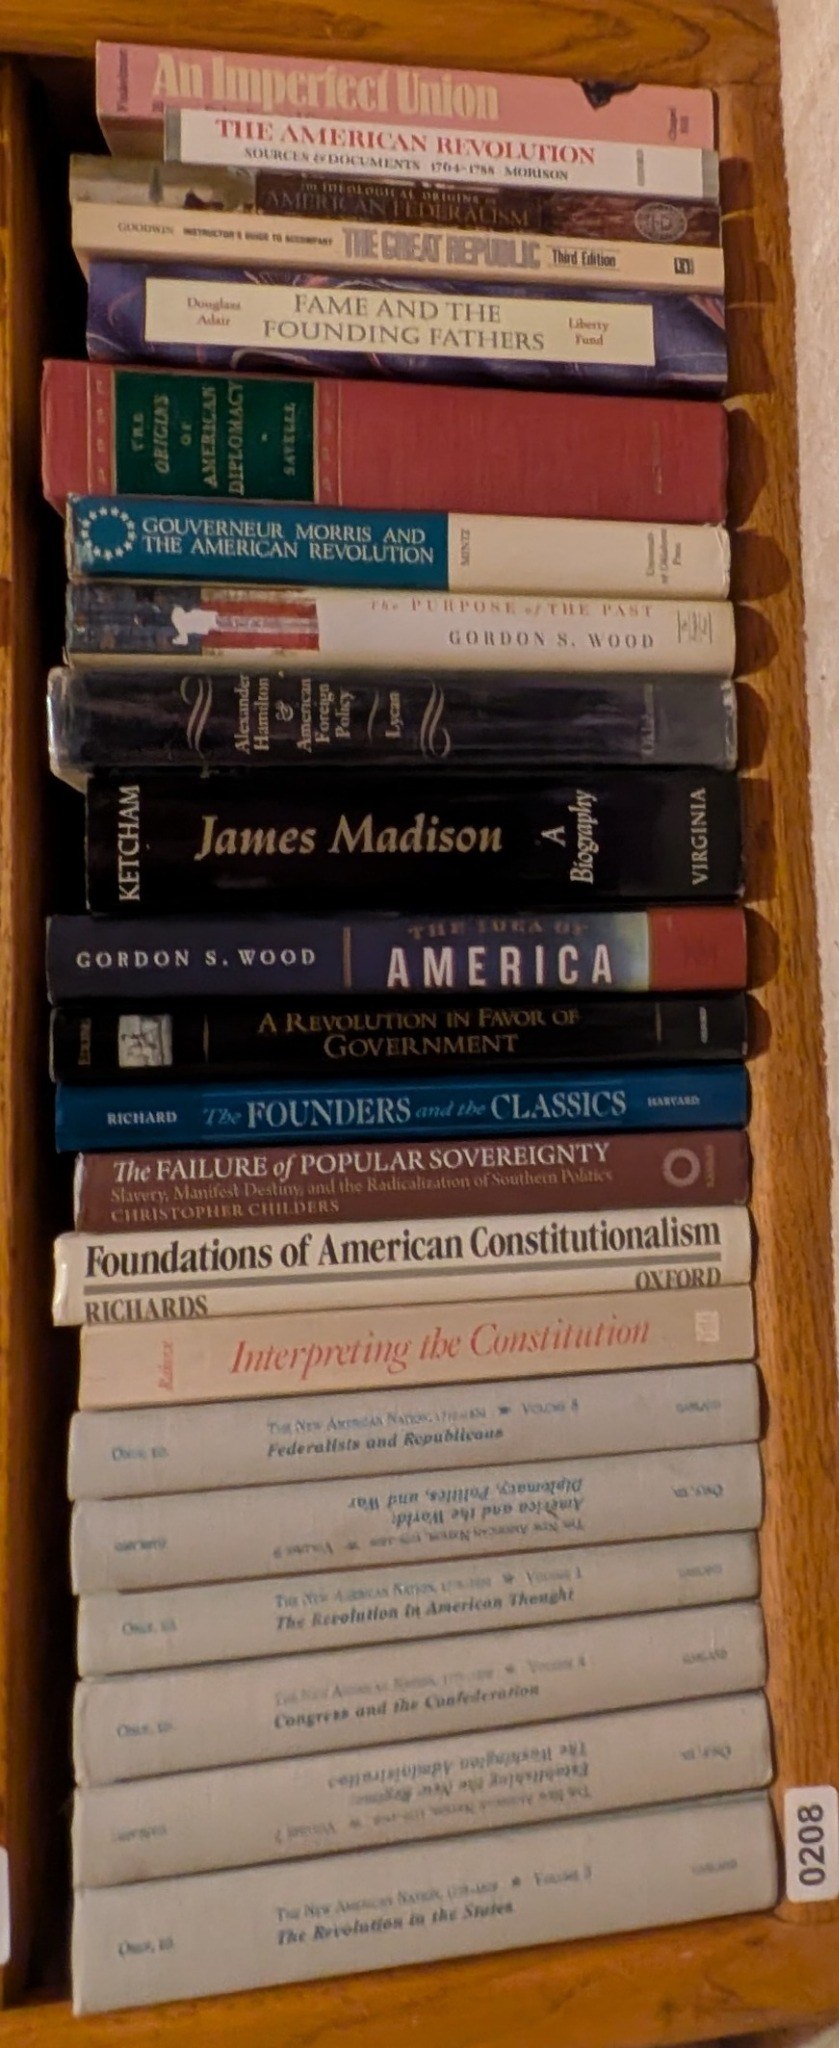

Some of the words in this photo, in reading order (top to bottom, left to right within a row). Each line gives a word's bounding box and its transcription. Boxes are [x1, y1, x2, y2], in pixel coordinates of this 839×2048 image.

[153, 52, 204, 98] An
[212, 55, 389, 112] Imperfect
[397, 69, 499, 121] Union
[215, 118, 273, 141] THE
[280, 123, 428, 152] AMERICAN
[437, 136, 596, 164] REVOLUTION
[245, 147, 309, 162] SOURCES
[328, 153, 420, 171] DOCUMENTS
[504, 166, 569, 181] MORISON
[266, 190, 386, 217] AMERICAN
[392, 200, 529, 227] FEDERALISM
[118, 222, 174, 235] GOODWIN
[342, 227, 377, 258] THE
[381, 229, 443, 264] GREAT
[446, 233, 541, 269] REPUBLIC
[553, 249, 577, 266] Third
[582, 251, 616, 267] Edition
[187, 297, 241, 311] Douglass
[295, 293, 367, 317] FAME
[377, 298, 438, 320] AND
[445, 302, 501, 323] THE
[196, 314, 231, 326] Adair
[263, 320, 420, 345] FOUNDING
[430, 327, 544, 351] FATHERS
[569, 317, 609, 332] Liberty
[575, 334, 603, 346] Fund
[154, 393, 170, 475] ORIGINS
[180, 421, 192, 446] OF
[201, 385, 218, 489] AMERICAN
[228, 380, 244, 496] DIPLOMACY
[141, 517, 283, 539] GOUVERNEUR
[295, 522, 372, 543] MORRIS
[384, 526, 426, 545] AND
[142, 536, 182, 554] THE
[191, 540, 298, 559] AMERICAN
[310, 543, 434, 565] REVOLUTION
[412, 599, 517, 616] PURPOSE
[550, 602, 585, 617] THE
[602, 603, 653, 618] PAST
[449, 630, 546, 647] GORDON
[557, 632, 575, 648] S.
[588, 632, 654, 649] WOOD
[234, 674, 250, 755] Alexander
[254, 678, 270, 751] Hamilton
[297, 678, 312, 753] American
[316, 683, 336, 744] Foreign
[335, 688, 355, 739] Policy
[386, 690, 405, 739] Lycan
[117, 784, 140, 901] KETCHAM
[194, 815, 317, 862] James
[328, 813, 504, 854] Madison
[541, 826, 566, 847] A
[569, 789, 599, 884] Biography
[690, 787, 709, 885] VIRGINIA
[408, 920, 465, 940] THE
[554, 921, 589, 936] OF
[76, 950, 190, 969] GORDON
[205, 950, 229, 967] S.
[237, 948, 317, 967] WOOD
[387, 944, 613, 988] AMERICA
[258, 1012, 277, 1034] A
[107, 1110, 178, 1126] RICHARD
[204, 1107, 242, 1126] The
[247, 1097, 411, 1129] FOUNDERS
[416, 1102, 452, 1118] and
[457, 1101, 486, 1117] the
[491, 1090, 626, 1120] CLASSICS
[648, 1096, 700, 1107] HARVARD
[113, 1160, 151, 1183] The
[157, 1155, 268, 1181] FAILURE
[273, 1156, 294, 1184] of
[300, 1149, 423, 1175] POPULAR
[429, 1142, 610, 1170] SOVEREIGNTY
[110, 1186, 170, 1205] Slavery,
[174, 1183, 239, 1201] Manifest
[245, 1182, 301, 1201] Destiny,
[307, 1180, 337, 1195] and
[339, 1179, 362, 1194] the
[367, 1171, 471, 1194] Radicalization
[474, 1170, 491, 1188] of
[492, 1168, 557, 1186] Southern
[561, 1167, 614, 1184] Politics
[111, 1204, 243, 1224] CHRISTOPHER
[248, 1200, 340, 1217] CHILDERS
[84, 1238, 273, 1278] Foundations
[281, 1232, 312, 1267] of
[317, 1228, 463, 1267] American
[470, 1215, 722, 1259] Constitutionalism
[636, 1267, 722, 1291] OXFORD
[84, 1295, 208, 1325] RICHARDS
[231, 1330, 412, 1381] Interpreting
[419, 1326, 461, 1361] the
[470, 1314, 651, 1358] Constitution
[266, 1435, 360, 1458] Federalists
[366, 1434, 397, 1450] and
[403, 1427, 504, 1448] Republicans
[387, 1491, 419, 1508] and
[425, 1485, 490, 1504] Politics,
[496, 1477, 584, 1497] Diplomacy,
[347, 1495, 379, 1512] War
[451, 1504, 476, 1521] the
[481, 1502, 505, 1519] and
[508, 1497, 584, 1515] America
[275, 1615, 303, 1631] The
[311, 1606, 398, 1628] Revolution
[404, 1601, 421, 1619] in
[425, 1596, 503, 1616] American
[509, 1586, 575, 1607] Thought
[274, 1709, 350, 1730] Congress
[355, 1702, 387, 1718] and
[394, 1694, 418, 1713] the
[425, 1684, 540, 1710] Confederation
[459, 1746, 553, 1774] Washington
[559, 1739, 588, 1760] The
[489, 1762, 589, 1789] Establishing
[798, 1802, 826, 1888] 0208
[276, 1927, 306, 1945] The
[313, 1915, 402, 1940] Revolution
[409, 1911, 425, 1927] in
[431, 1906, 457, 1924] the
[462, 1900, 514, 1920] States
